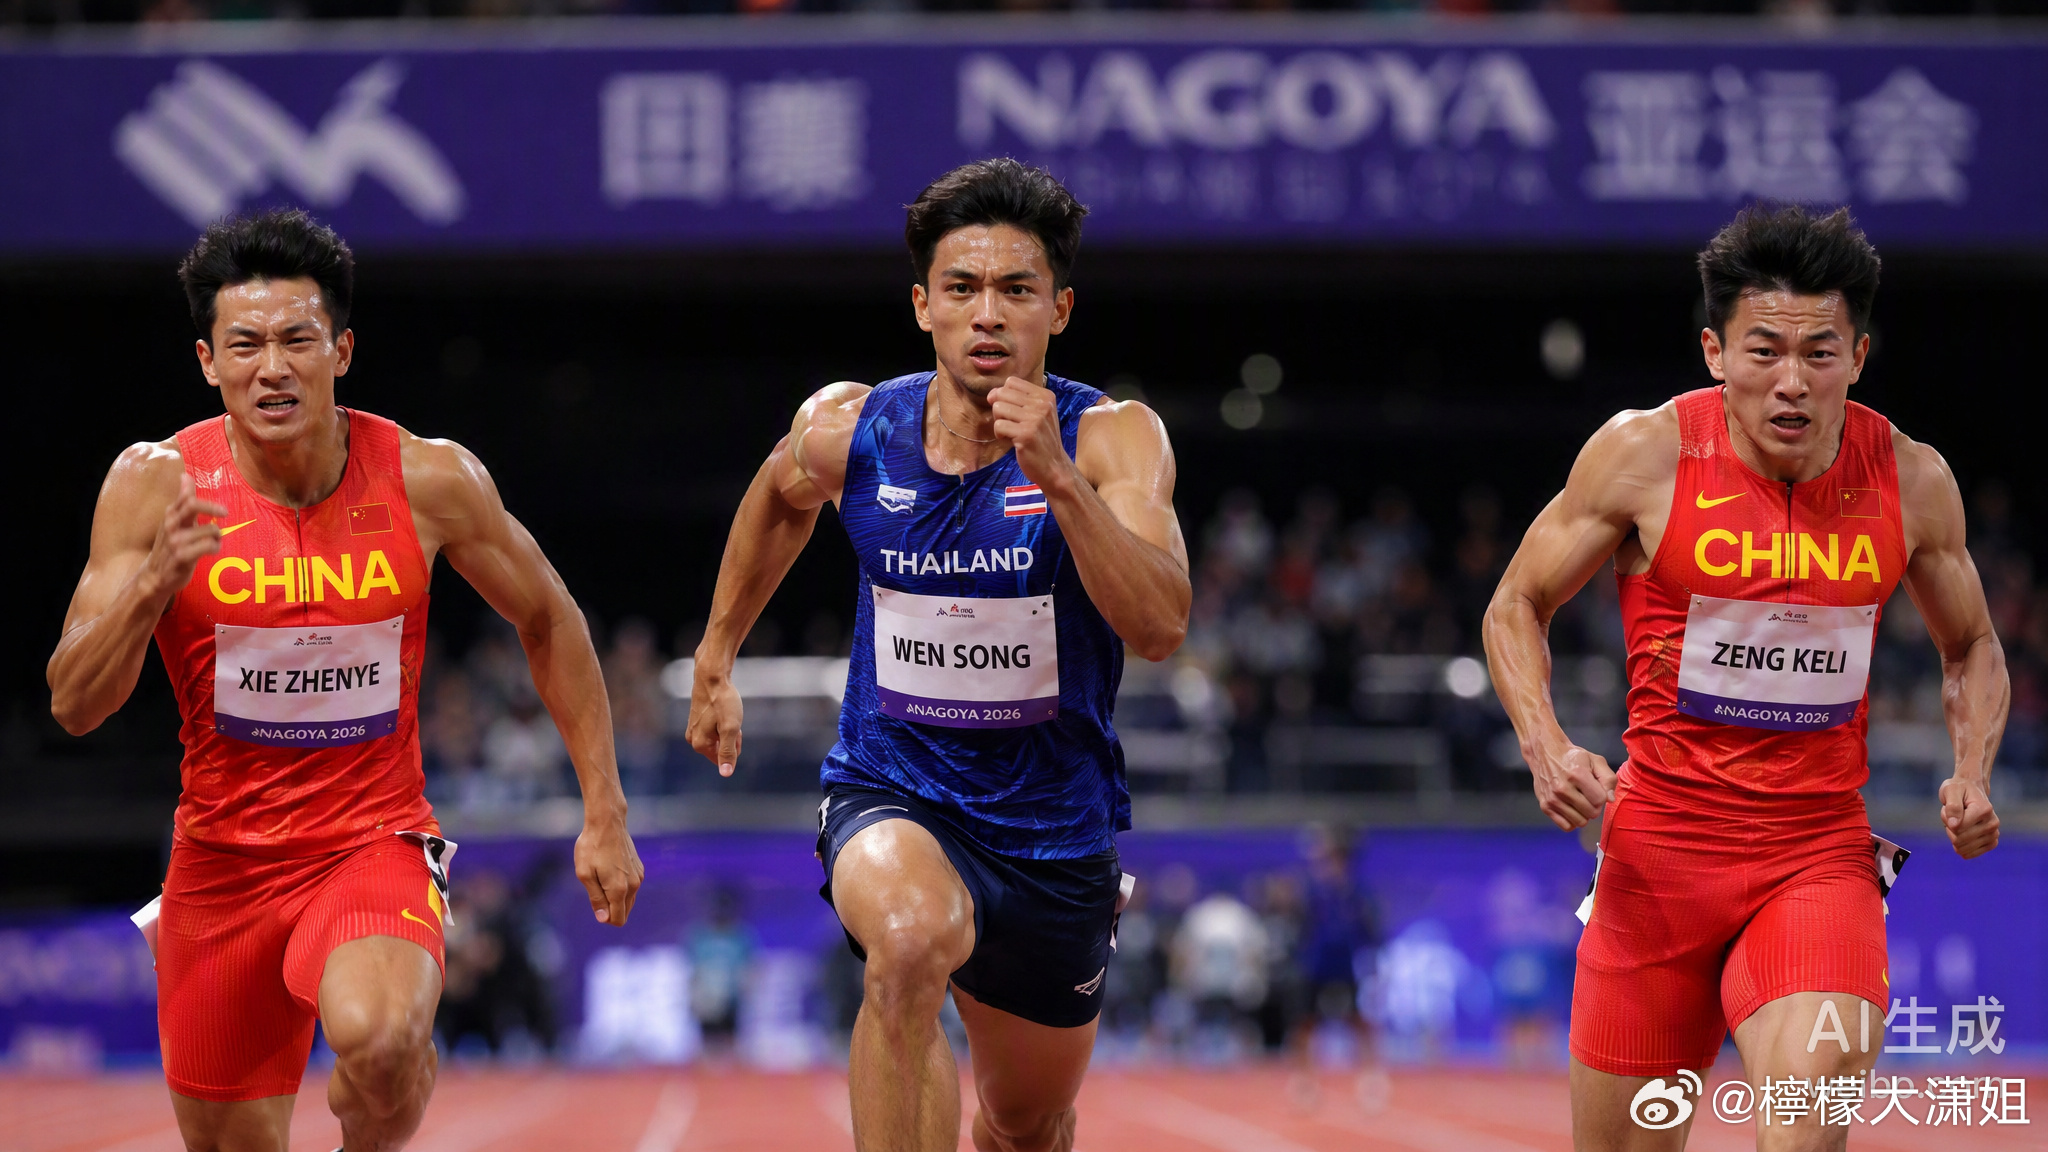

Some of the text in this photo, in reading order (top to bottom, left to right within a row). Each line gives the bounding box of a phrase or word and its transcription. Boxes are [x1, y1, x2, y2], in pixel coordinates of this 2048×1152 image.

[956, 49, 1555, 149] NAGOYA
[1583, 66, 1976, 206] 亚运会
[880, 547, 1034, 575] THAILAND
[1694, 528, 1882, 583] CHINA
[208, 550, 401, 604] CHINA
[892, 635, 1031, 669] WEN SONG
[1711, 641, 1847, 674] ZENG KELI
[238, 661, 380, 694] XIE ZHENYE
[913, 706, 1021, 721] NAGOYA 2026
[1724, 706, 1830, 724] NAGOYA 2026
[259, 725, 366, 740] NAGOYA 2026
